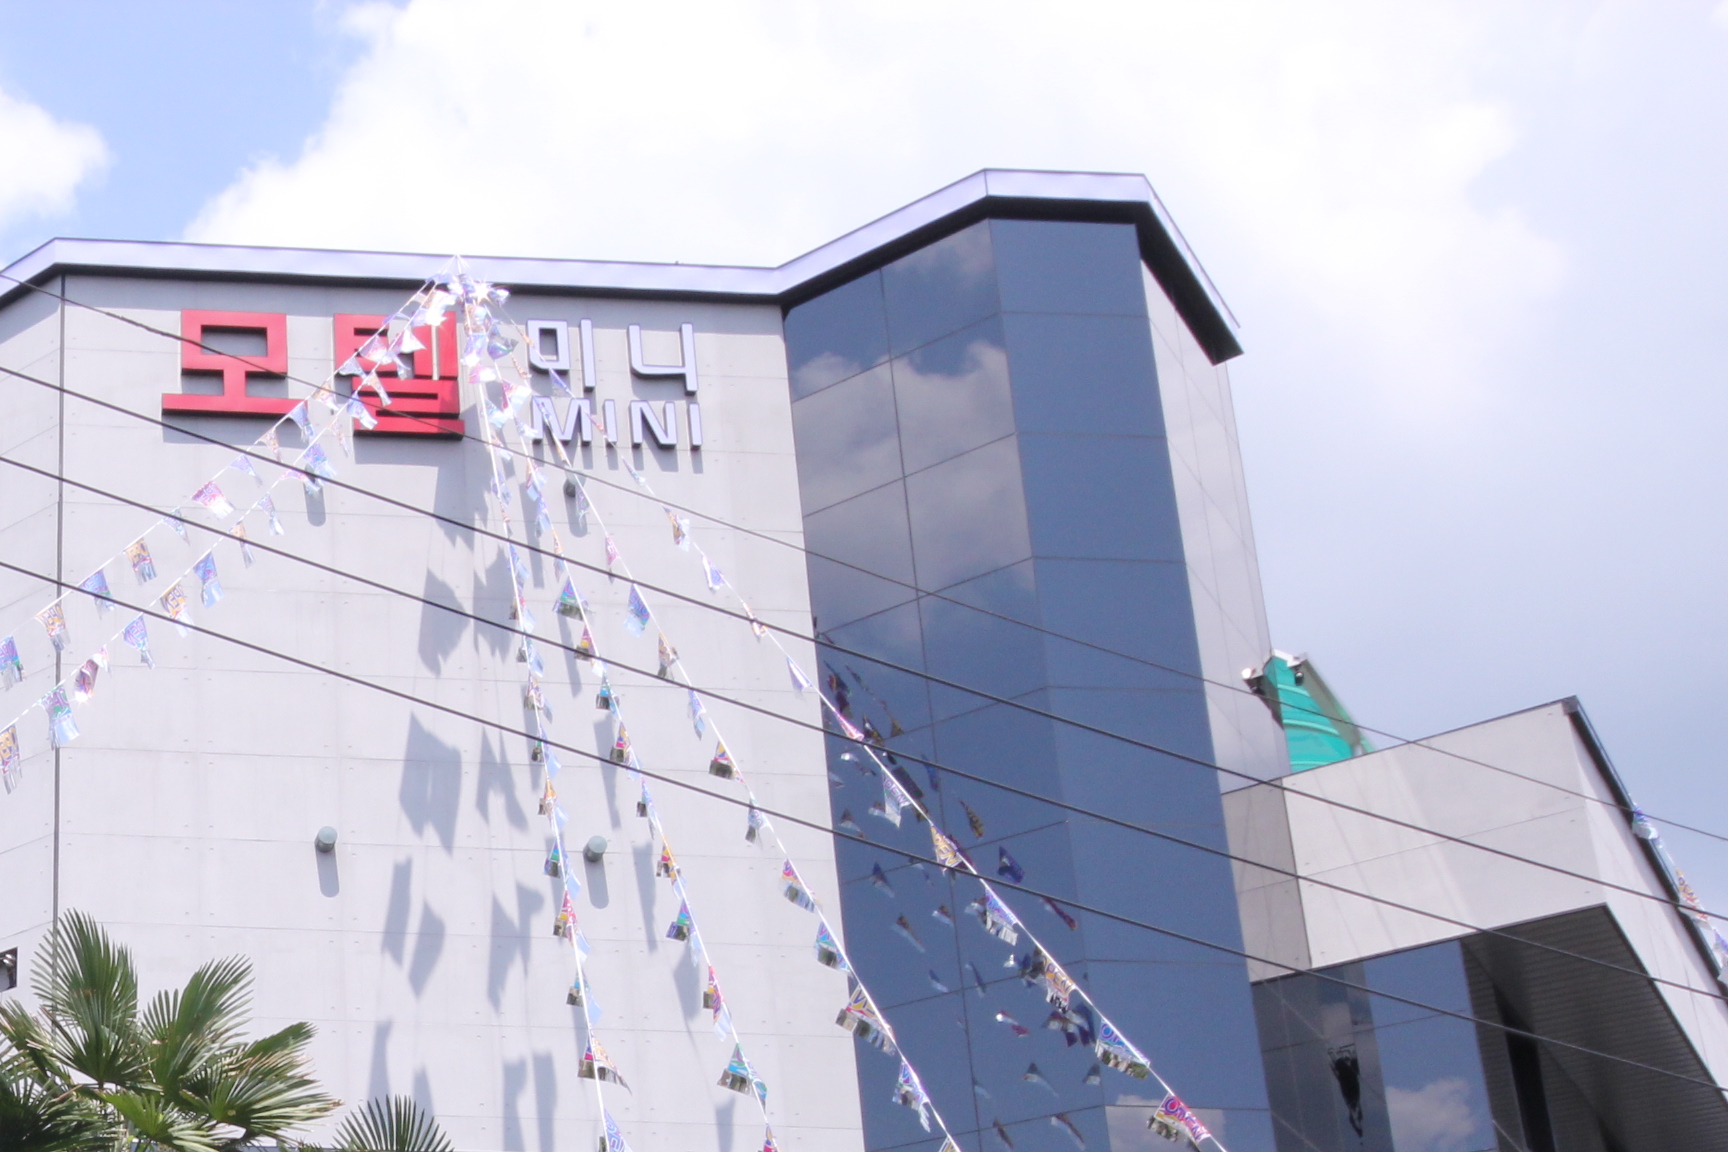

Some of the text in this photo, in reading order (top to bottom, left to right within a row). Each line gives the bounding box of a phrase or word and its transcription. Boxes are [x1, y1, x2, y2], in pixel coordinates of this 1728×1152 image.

[161, 309, 698, 437] 모텔 미니
[531, 396, 702, 450] MINI
